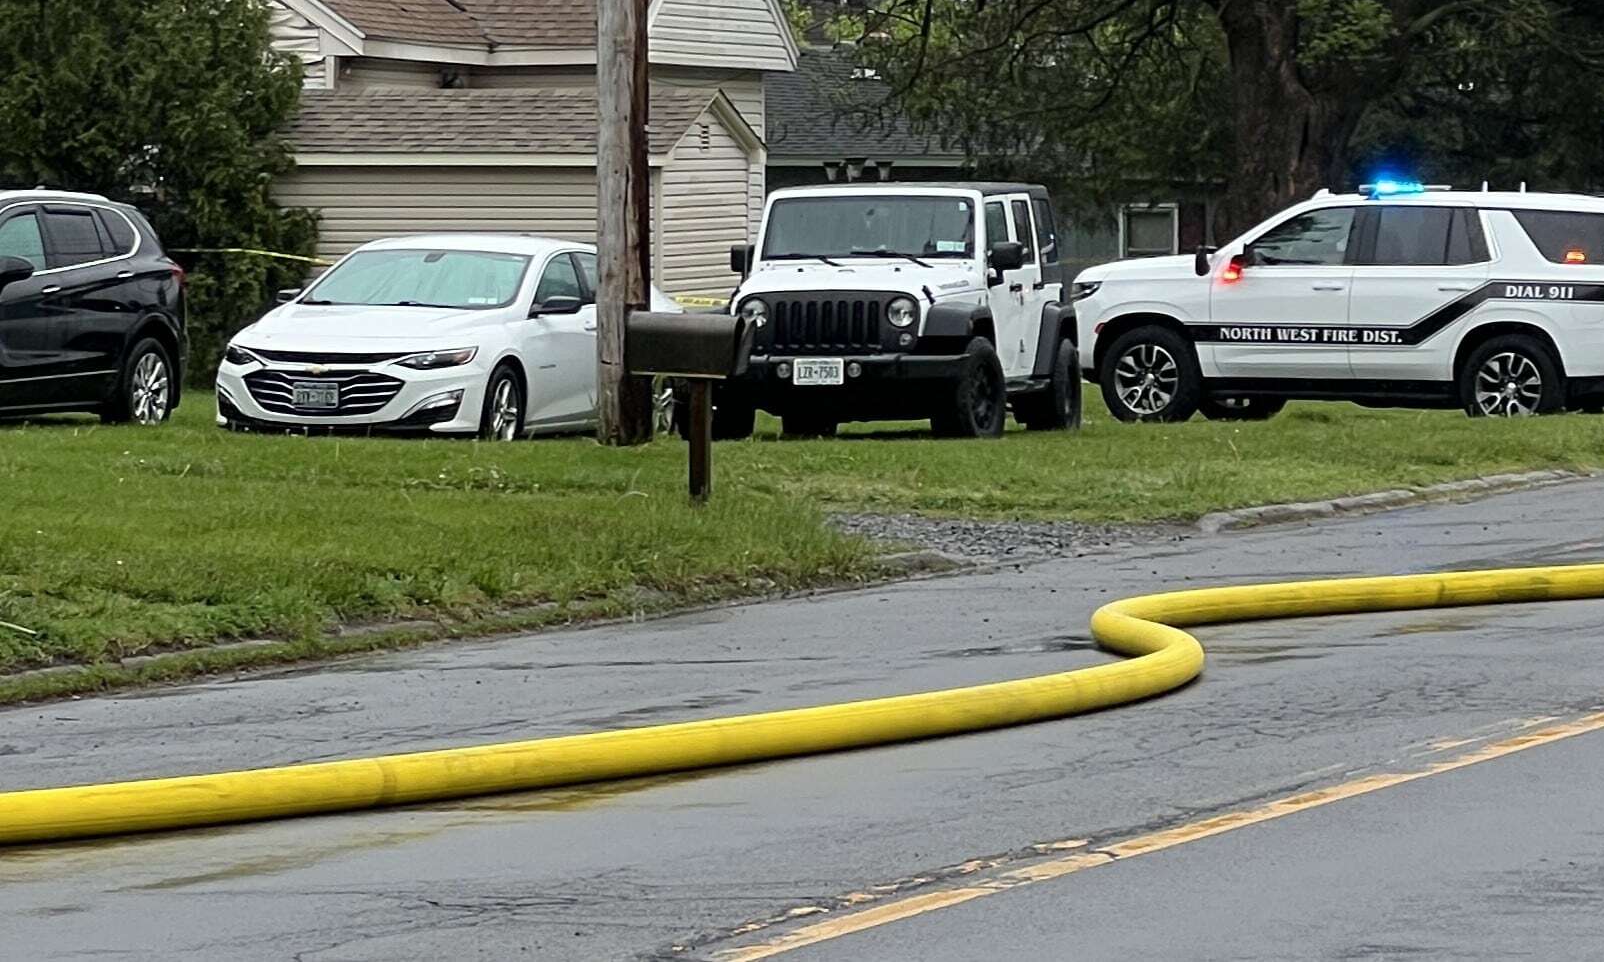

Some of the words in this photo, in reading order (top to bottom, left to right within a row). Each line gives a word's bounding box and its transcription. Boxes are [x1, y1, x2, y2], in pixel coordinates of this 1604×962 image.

[1505, 285, 1544, 298] DIAL
[1549, 286, 1574, 299] 911
[1219, 327, 1272, 340] NORTH
[1277, 328, 1319, 341] WEST
[1322, 329, 1358, 342] FIRE
[1362, 330, 1403, 343] DIST.
